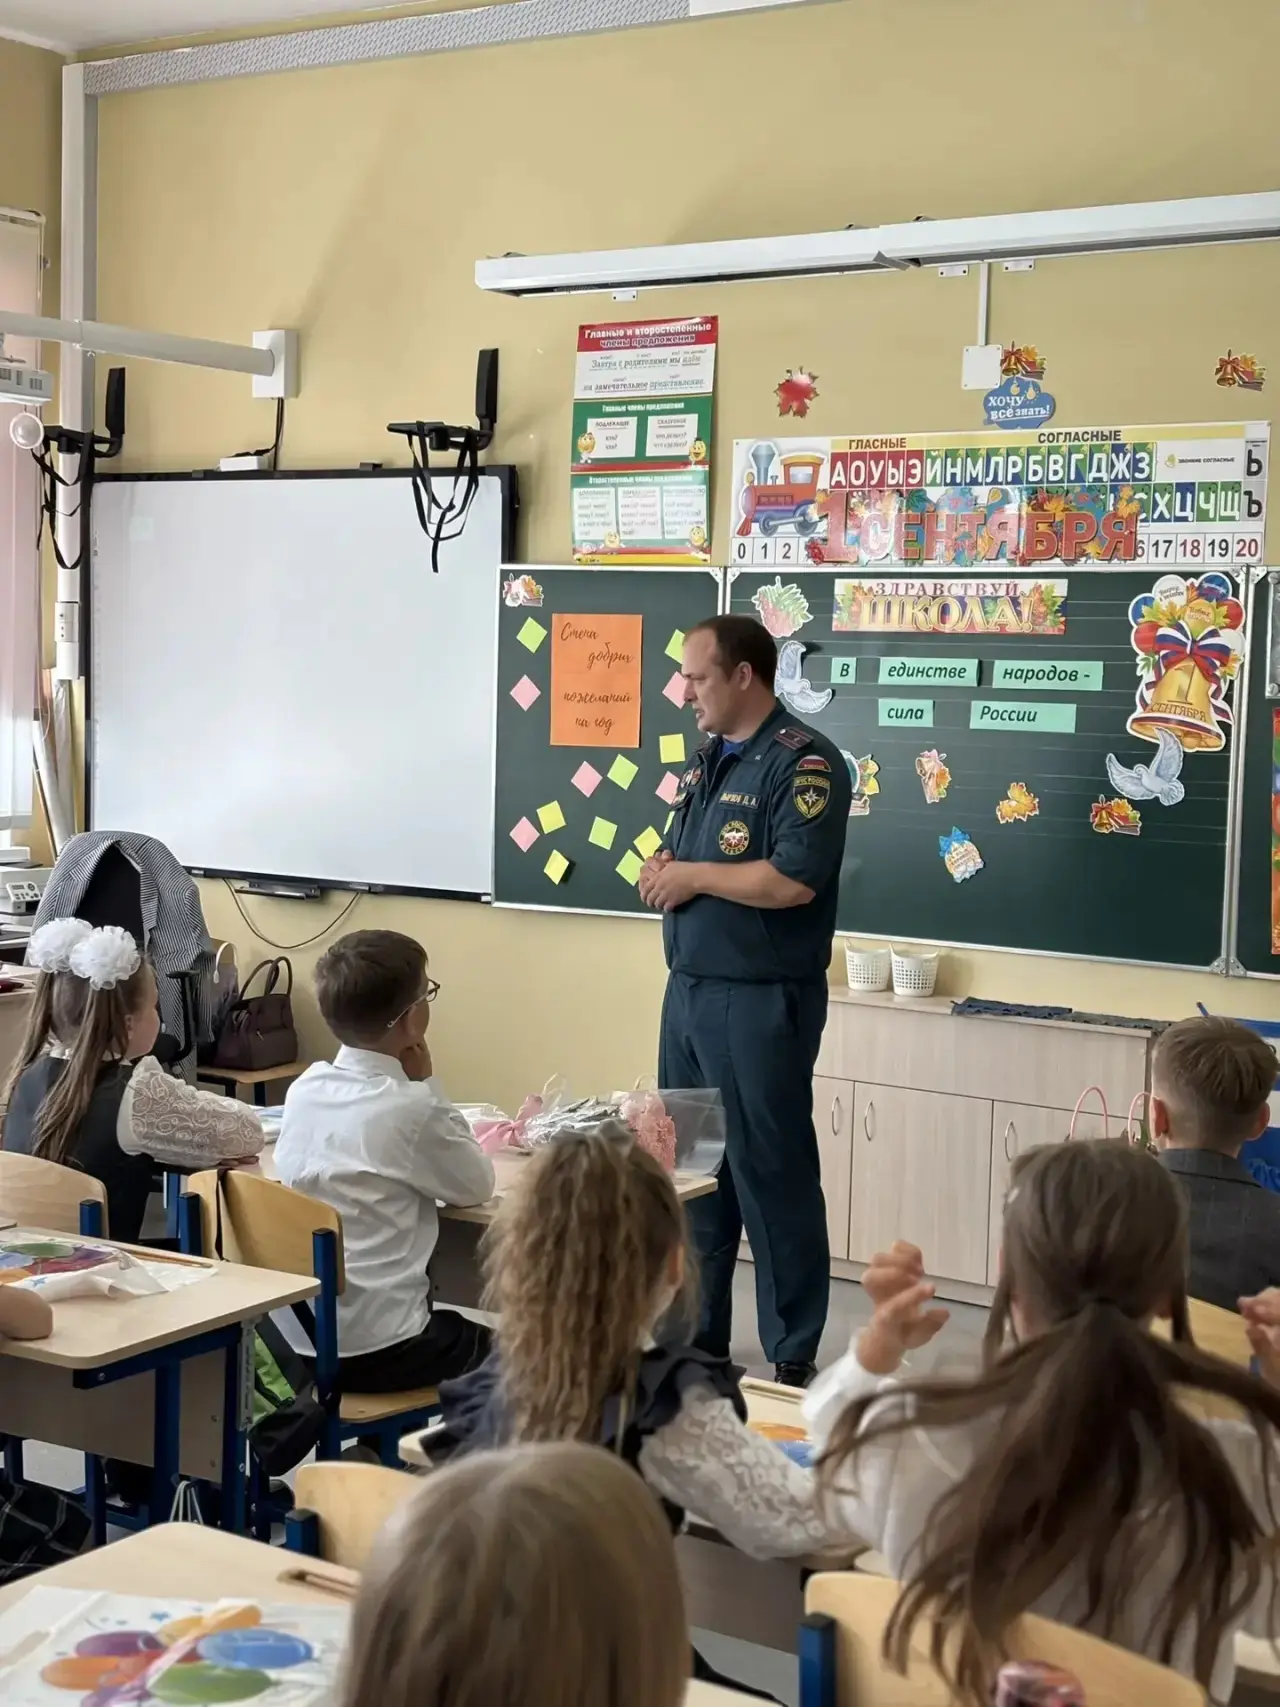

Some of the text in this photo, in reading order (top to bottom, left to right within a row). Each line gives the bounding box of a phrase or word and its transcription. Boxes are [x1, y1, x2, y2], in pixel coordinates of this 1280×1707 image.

[585, 323, 712, 339] Главные и второстепенные
[600, 334, 696, 348] члены предложения
[592, 360, 617, 368] Завтра
[624, 358, 668, 368] родителями
[849, 438, 907, 450] ГЛАСНЫЕ
[1038, 430, 1122, 444] СОГЛАСНЫЕ
[819, 490, 1138, 562] 1 СЕНТЯБРЯ
[738, 543, 746, 559] 0
[761, 542, 768, 559] 1
[782, 542, 791, 559] 2
[1151, 539, 1173, 558] 17
[1179, 539, 1200, 558] 18
[1208, 539, 1228, 558] 19
[1236, 538, 1258, 558] 20
[859, 596, 1036, 634] ШКОЛА!
[560, 622, 599, 642] Стена
[840, 664, 850, 677] В
[888, 662, 967, 678] единстве
[1002, 665, 1078, 684] народов
[564, 691, 632, 704] пожеланий
[887, 706, 1038, 723] сила России
[1151, 703, 1207, 722] СЕНТЯБРЯ
[575, 716, 615, 736] на год
